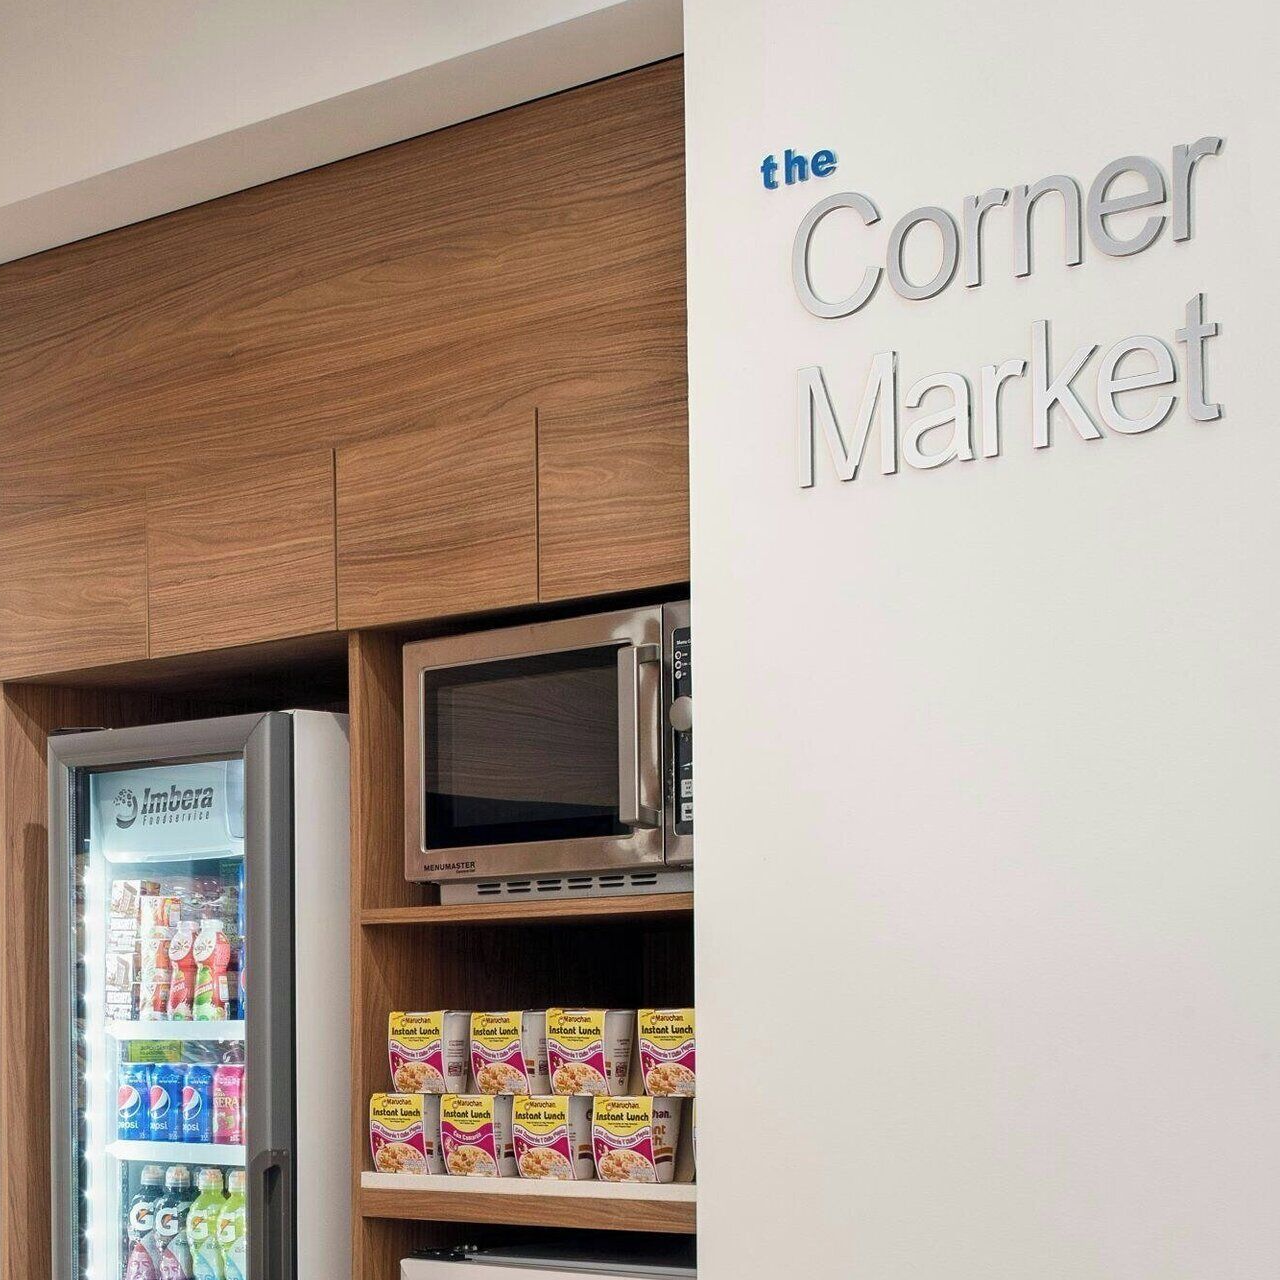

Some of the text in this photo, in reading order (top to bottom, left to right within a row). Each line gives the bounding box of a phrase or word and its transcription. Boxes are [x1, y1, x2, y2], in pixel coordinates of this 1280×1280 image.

[760, 146, 838, 189] the
[792, 136, 1225, 319] Corner
[796, 293, 1223, 488] Market
[141, 785, 214, 814] Imbera
[143, 811, 210, 826] Foodservice
[424, 862, 475, 871] MENUMASTER
[391, 1026, 440, 1035] Instant Lunch
[473, 1026, 518, 1035] Instant Lunch
[549, 1026, 601, 1035] Instant Lunch
[641, 1025, 693, 1034] Instant Lunch
[373, 1108, 420, 1117] Instant Lunch
[444, 1109, 491, 1119] Instant Lunch
[516, 1111, 565, 1120] Instant Lunch
[596, 1112, 623, 1121] Instant
[625, 1112, 649, 1121] Lunch
